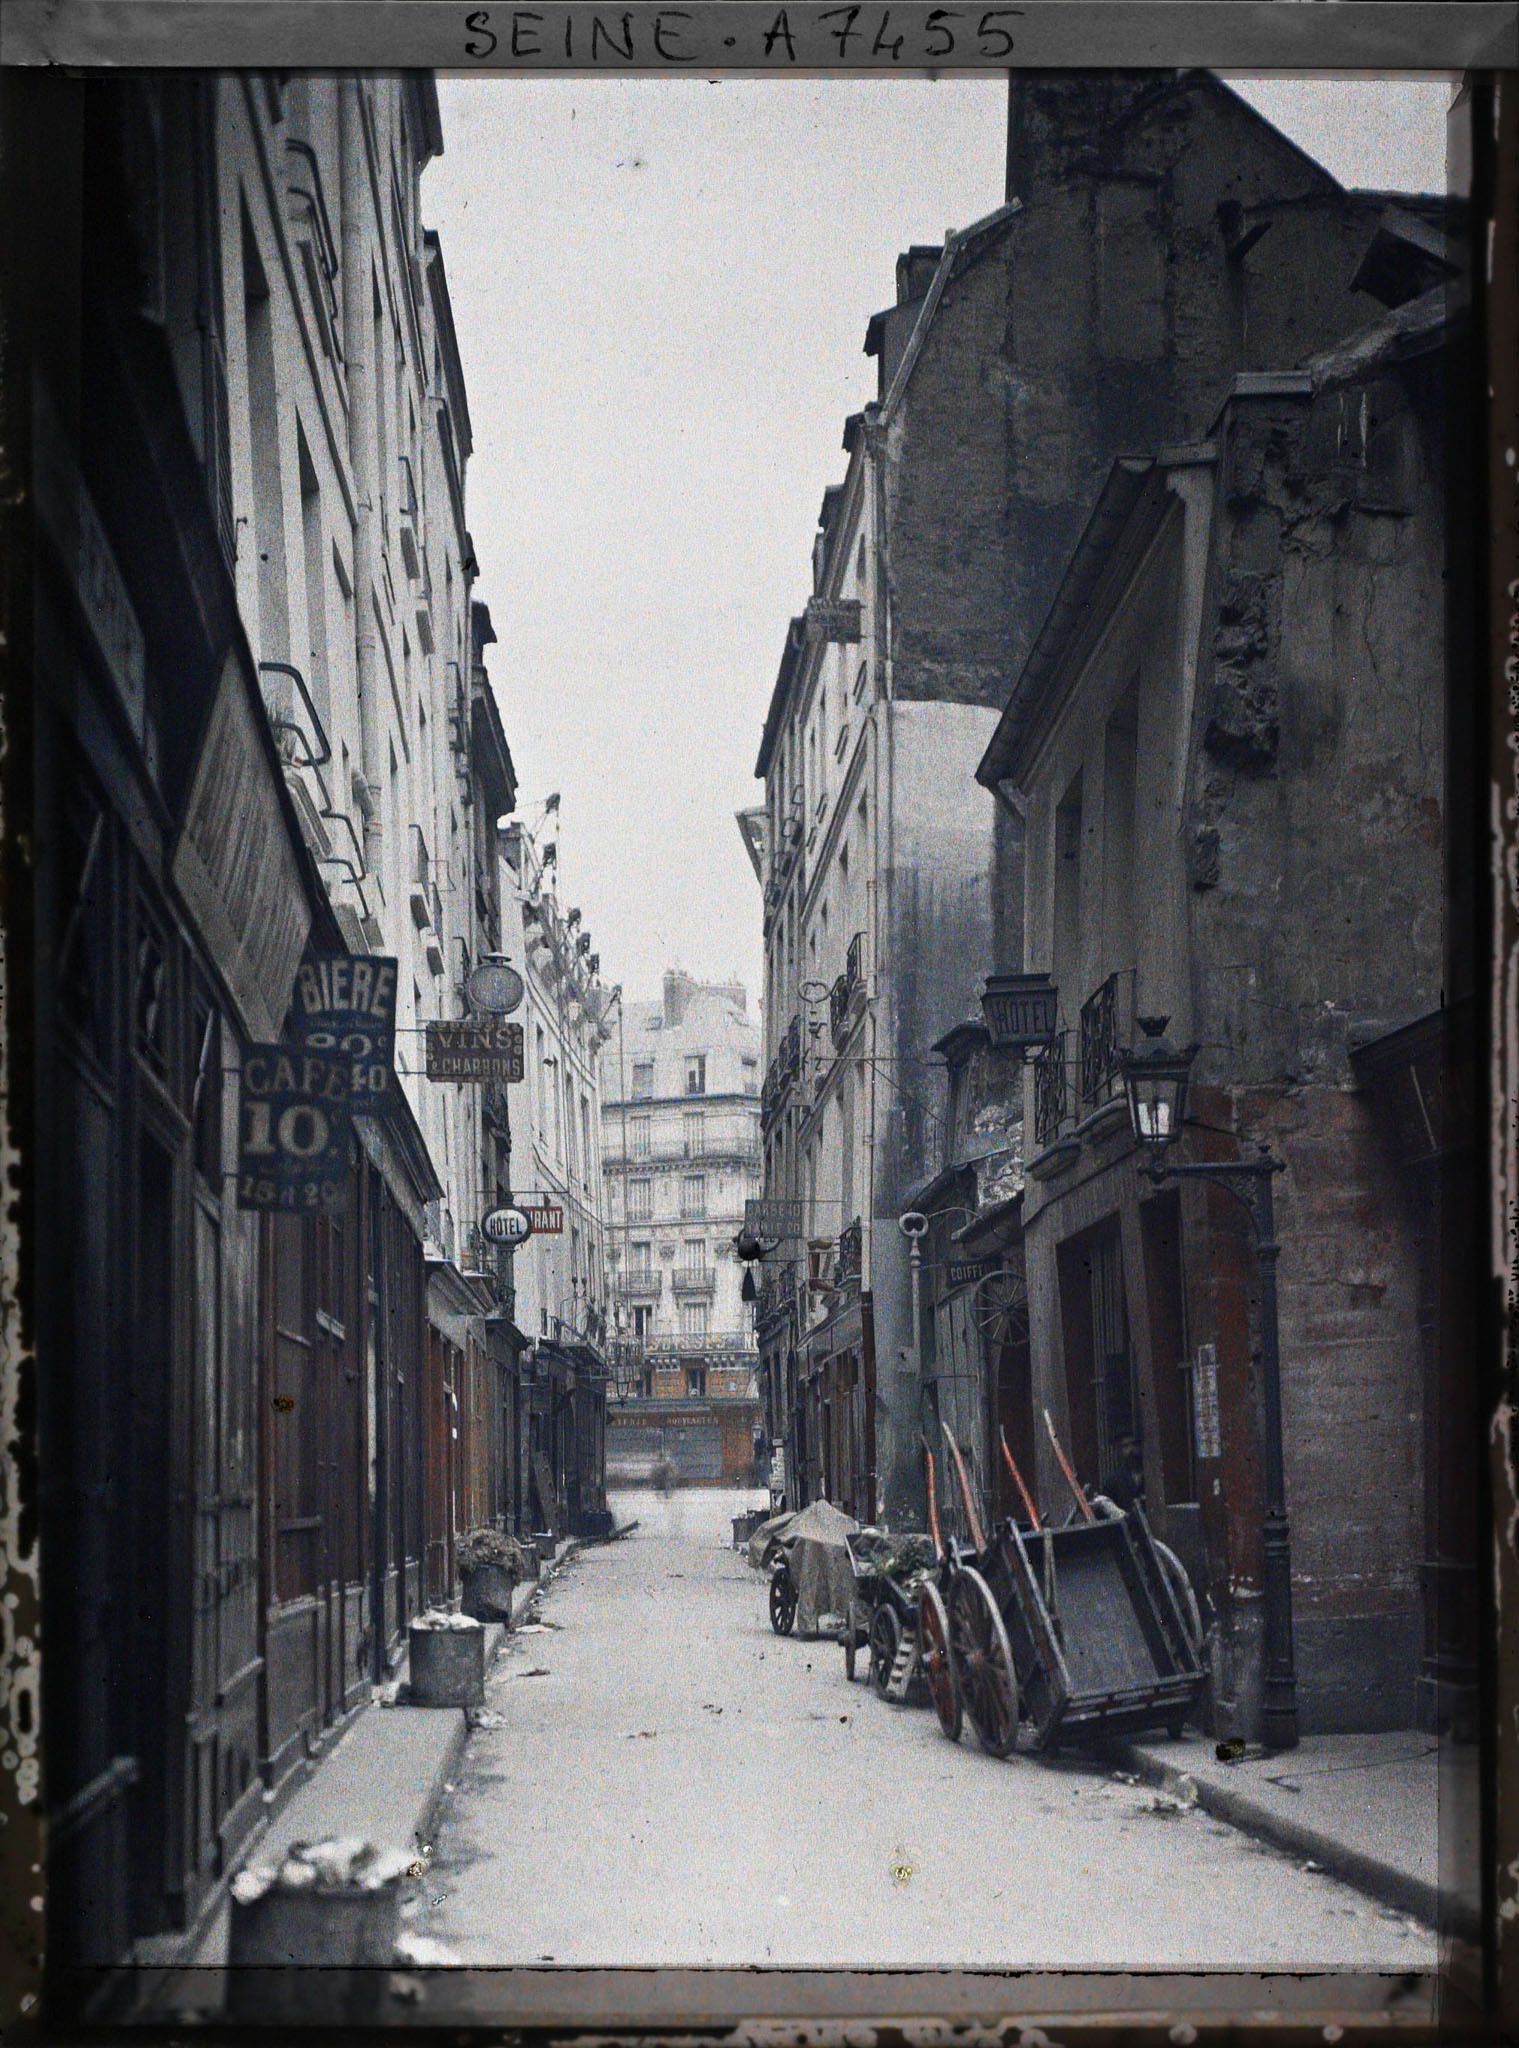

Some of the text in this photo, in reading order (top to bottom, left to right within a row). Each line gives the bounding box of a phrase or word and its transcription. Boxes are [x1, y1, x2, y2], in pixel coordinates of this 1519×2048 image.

[464, 11, 697, 62] SEINE
[437, 1026, 512, 1050] VINS
[243, 1101, 329, 1156] 10
